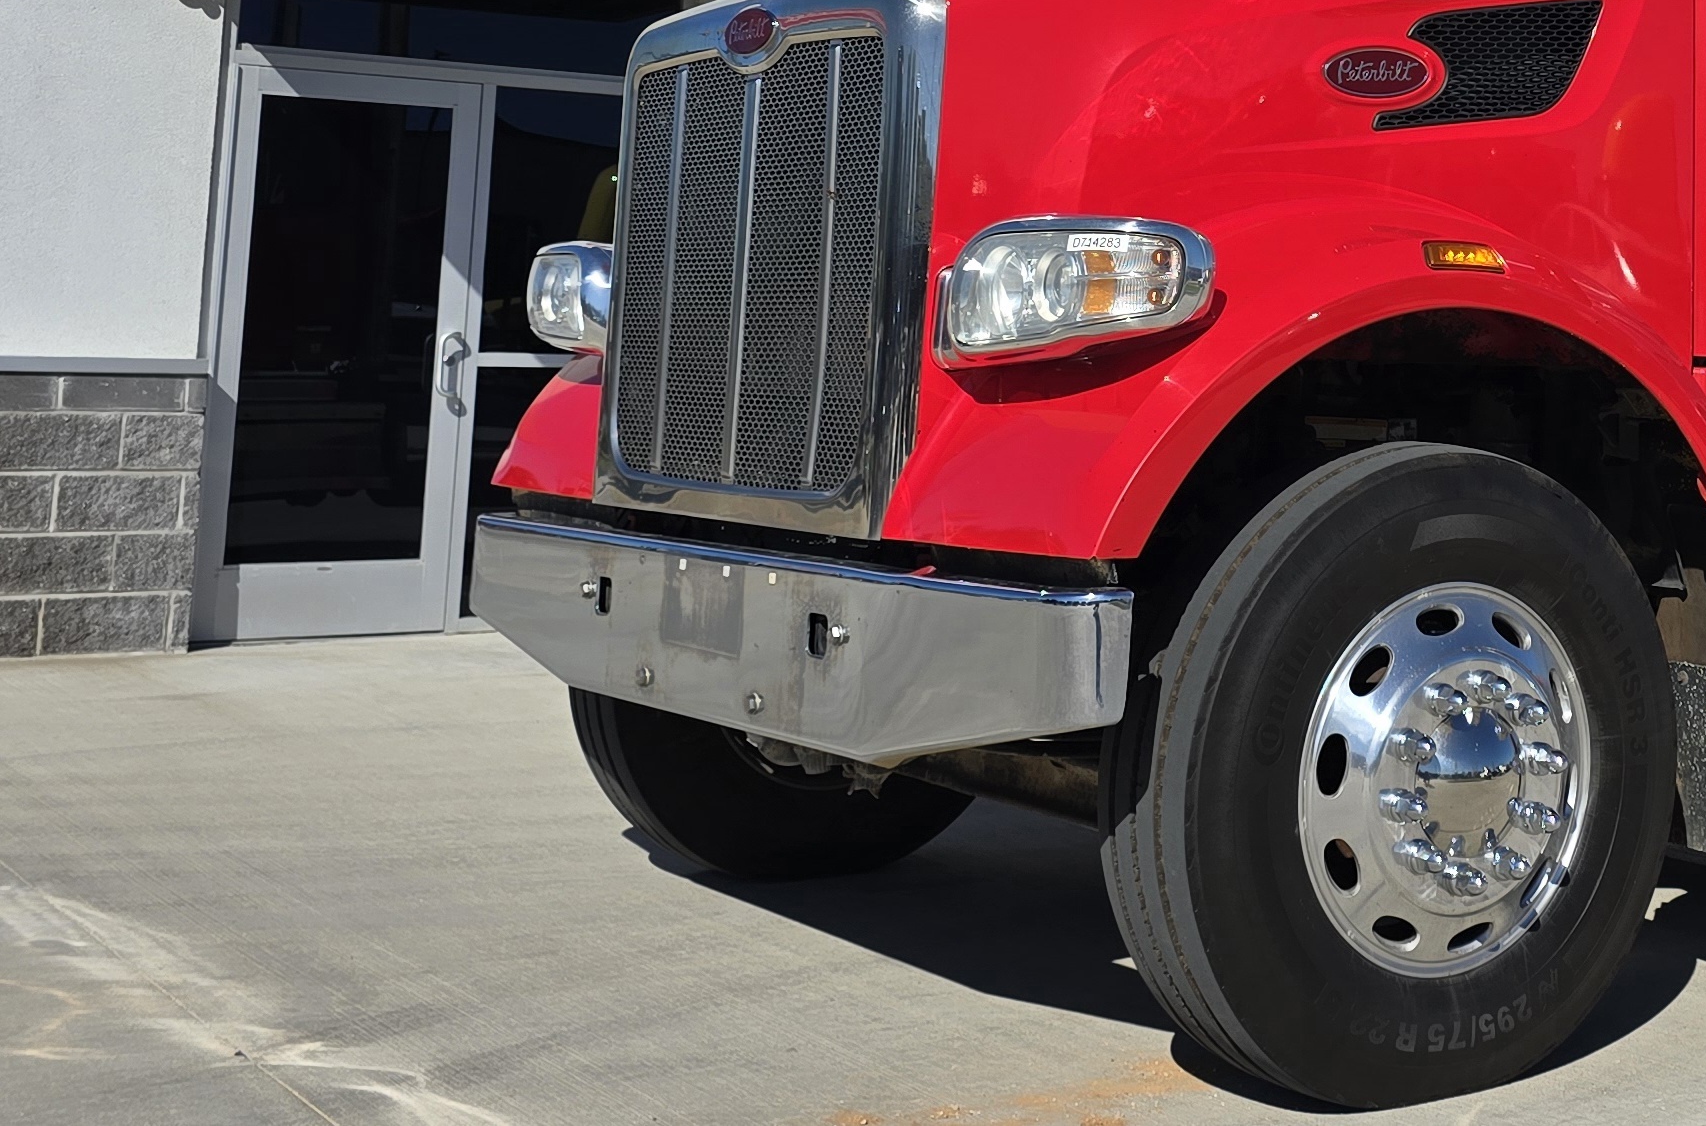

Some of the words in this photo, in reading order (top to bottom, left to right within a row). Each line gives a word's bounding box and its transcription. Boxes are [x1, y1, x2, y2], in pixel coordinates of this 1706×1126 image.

[1337, 57, 1419, 84] Peterbilt
[1612, 646, 1650, 724] HSR
[1394, 1021, 1419, 1053] R
[1426, 993, 1534, 1053] 295/75
